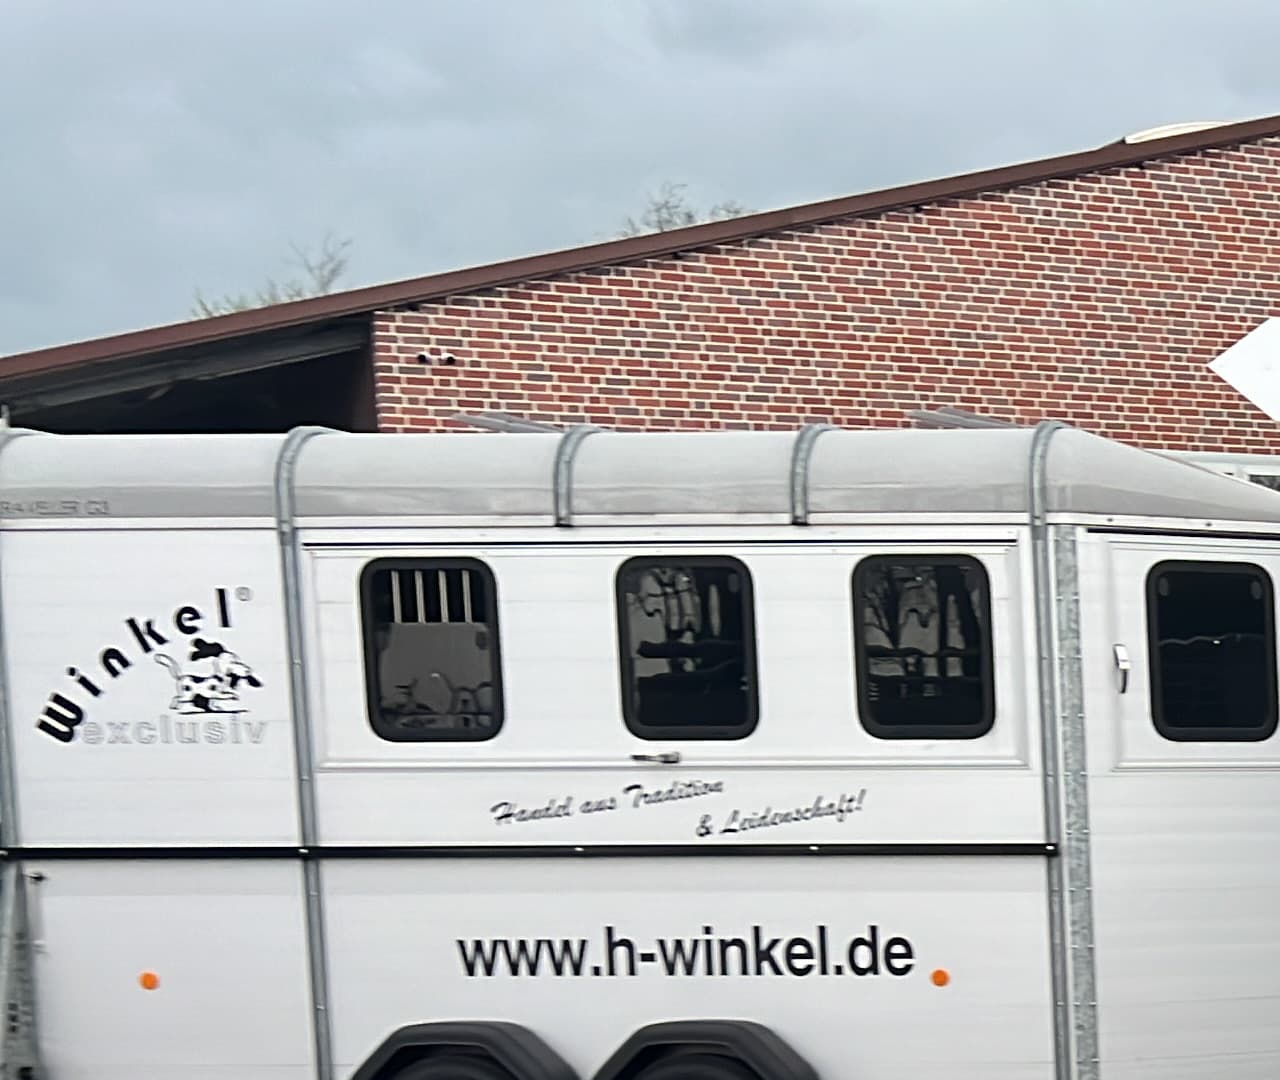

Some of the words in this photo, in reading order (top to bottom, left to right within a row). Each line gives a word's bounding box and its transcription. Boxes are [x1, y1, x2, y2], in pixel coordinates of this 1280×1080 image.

[82, 714, 268, 745] exclusiv
[490, 796, 574, 826] Handel
[579, 796, 617, 815] aus
[622, 779, 724, 809] Tradition
[696, 815, 713, 837] &
[456, 925, 916, 977] www.h-winkel.de
